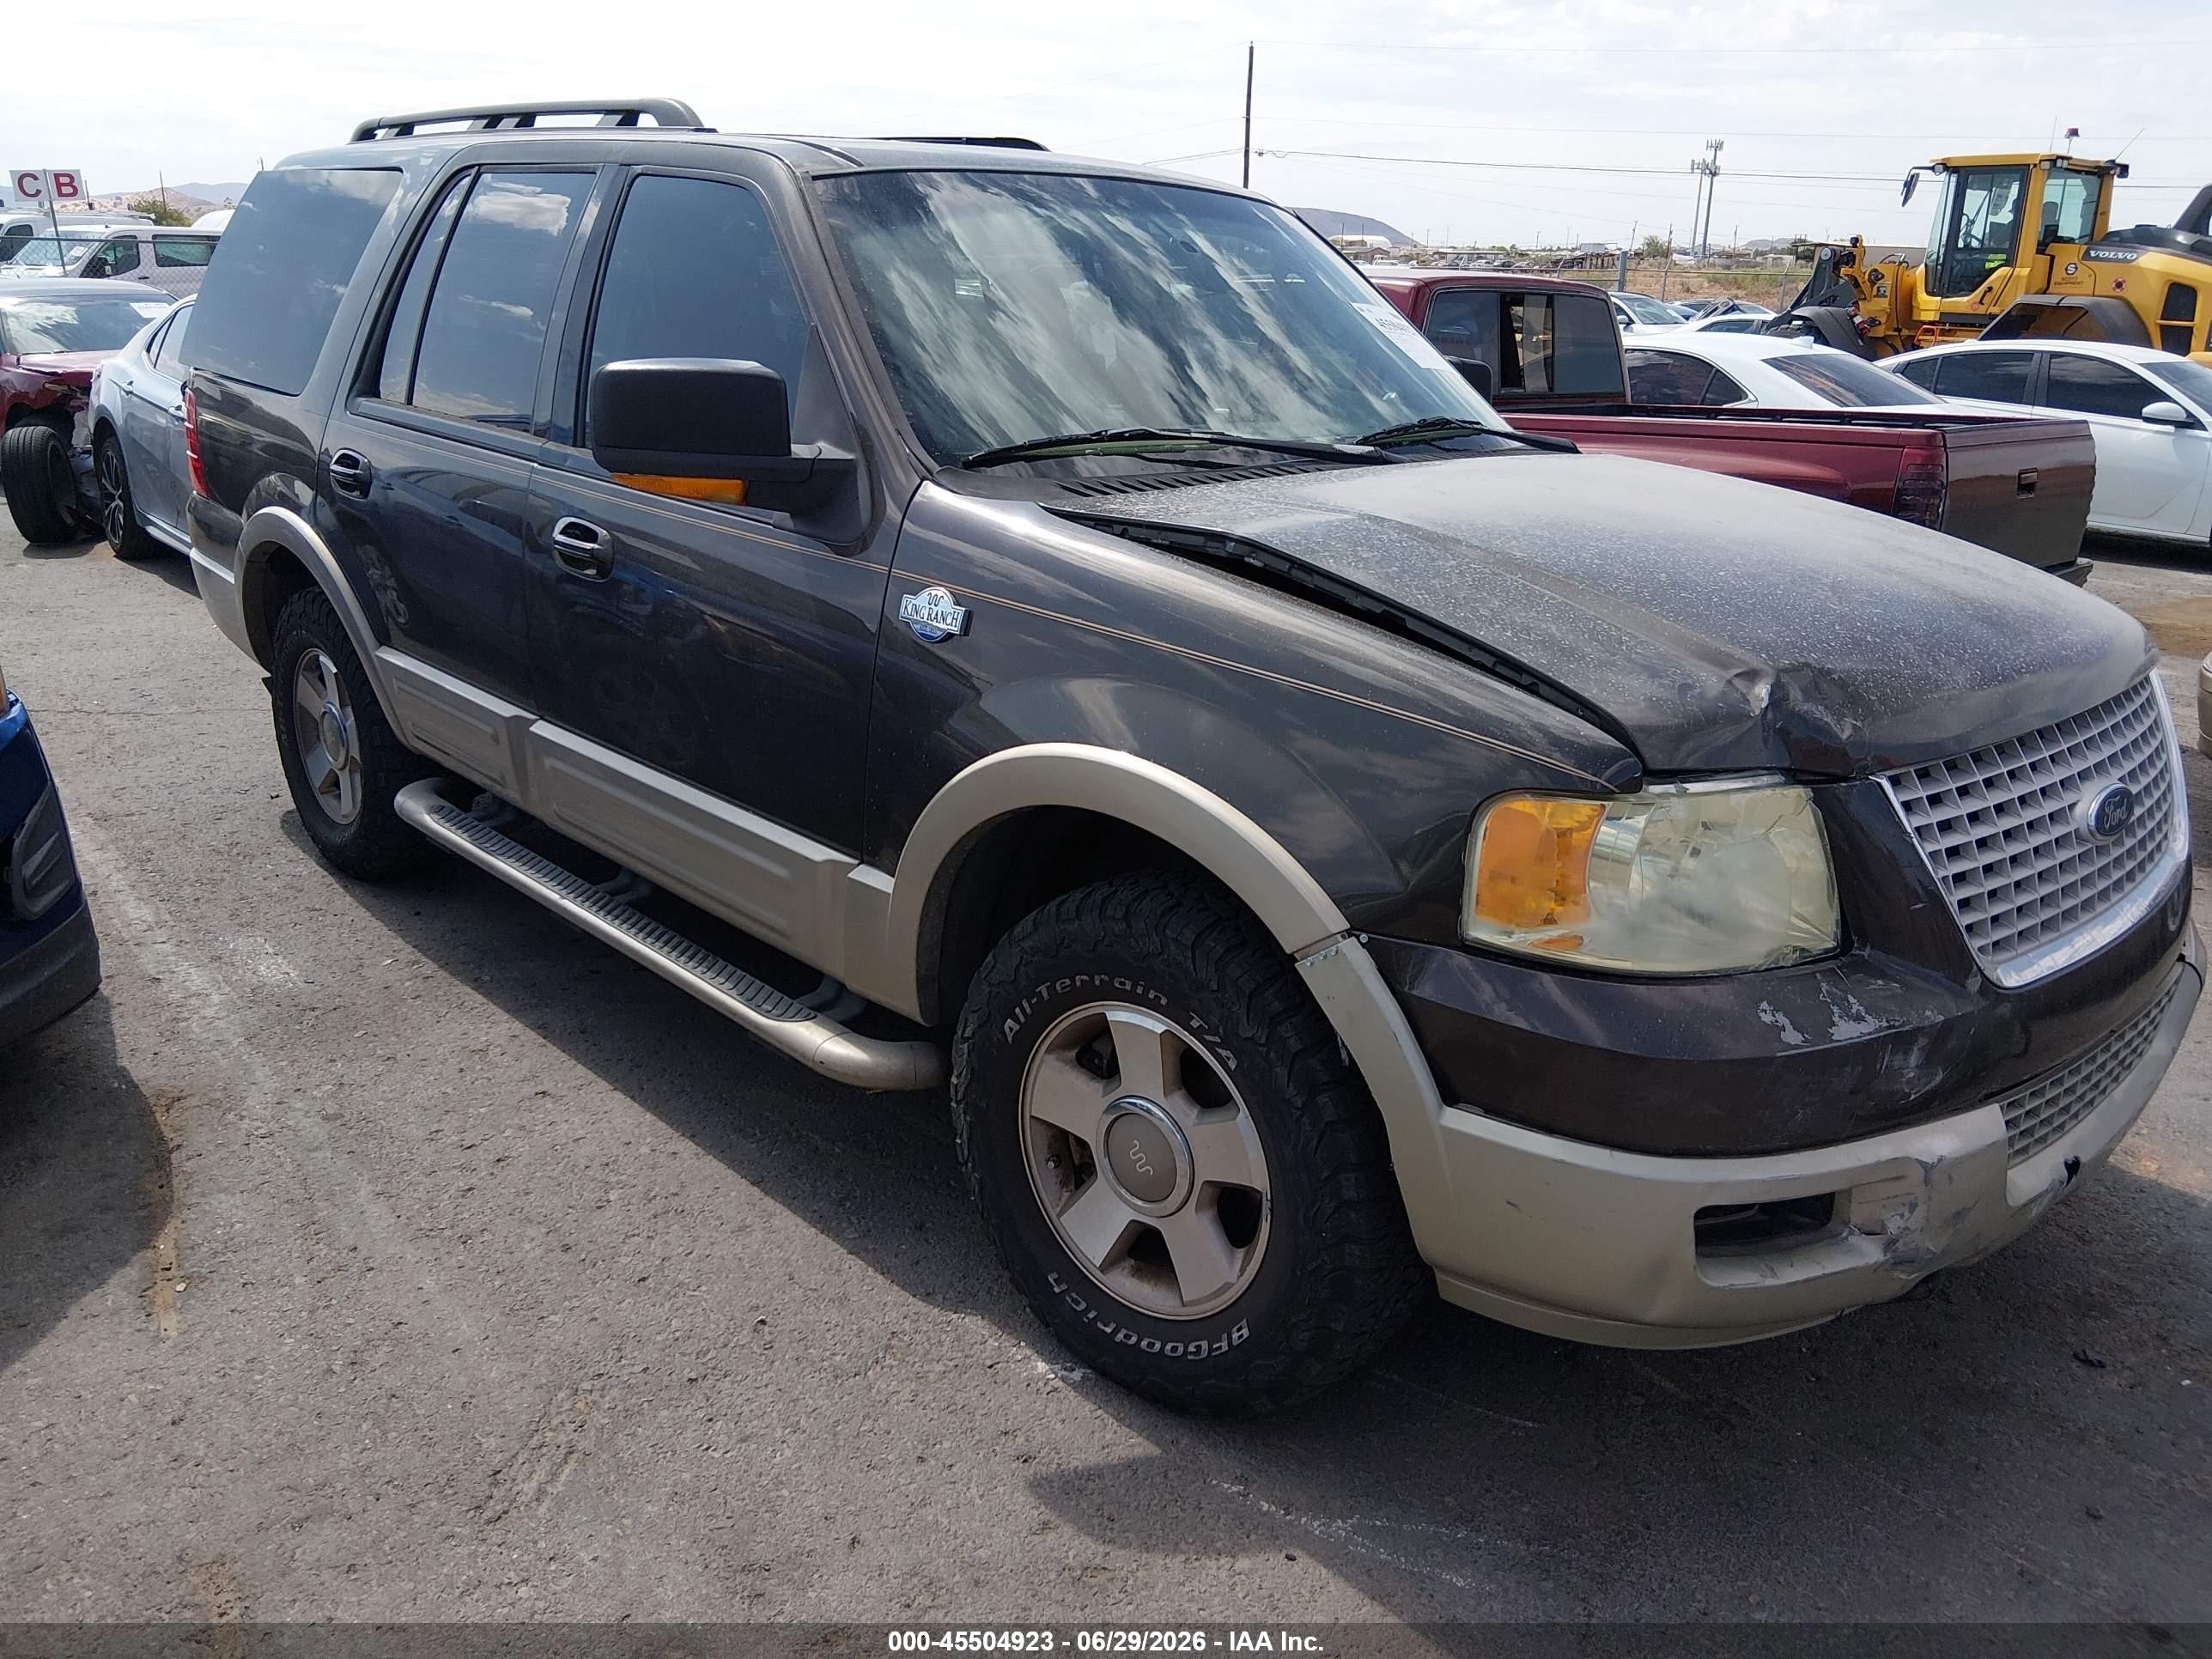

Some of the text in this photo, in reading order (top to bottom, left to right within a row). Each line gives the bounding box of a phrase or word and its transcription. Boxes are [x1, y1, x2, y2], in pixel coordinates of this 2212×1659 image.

[18, 173, 79, 198] C B
[2089, 251, 2137, 259] VOLVO
[902, 599, 960, 628] KING RANCH
[2104, 795, 2128, 830] Ford
[1003, 974, 1238, 1072] All-Terrain T/A
[1047, 1272, 1250, 1360] BFGoodrich
